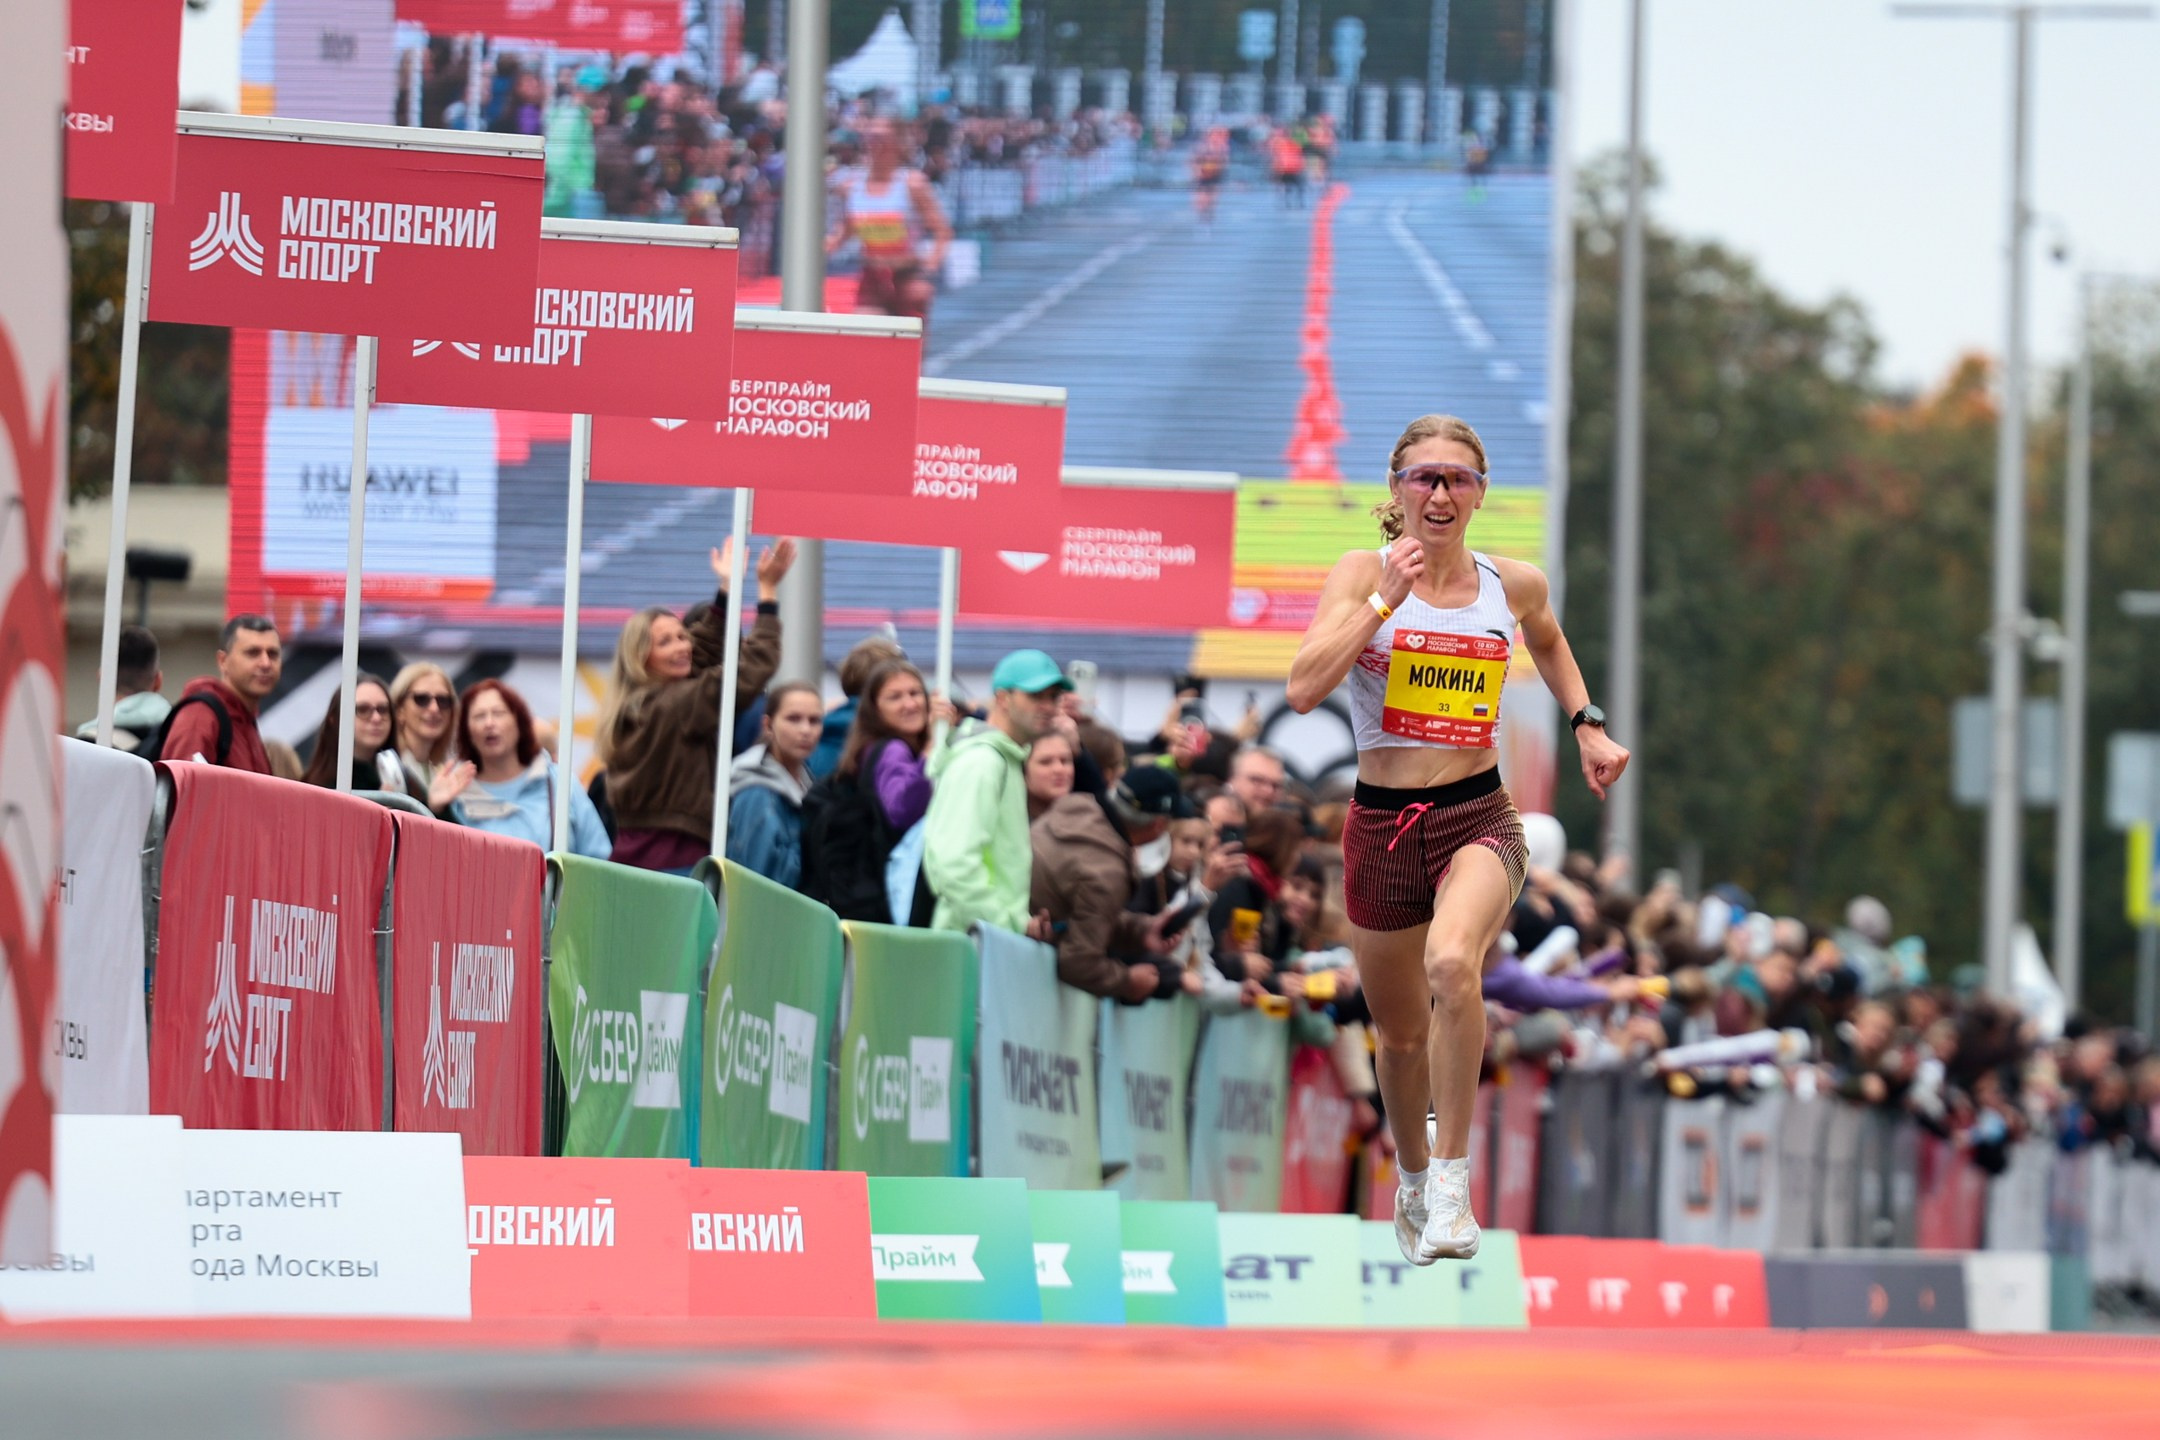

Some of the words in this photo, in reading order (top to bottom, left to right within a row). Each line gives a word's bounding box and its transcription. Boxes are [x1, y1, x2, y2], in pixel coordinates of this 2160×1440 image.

[280, 196, 497, 250] МОСКОВСКИЙ
[278, 239, 381, 284] СПОРТ
[534, 287, 694, 333] СКОВСКИЙ
[729, 396, 871, 421] ОСКОВСКИЙ
[913, 478, 978, 501] АФОН
[1062, 540, 1197, 566] МОСКОВСКИЙ
[1060, 557, 1161, 581] МАРАФОН
[1426, 645, 1457, 654] МАРАФОН
[1427, 640, 1469, 650] МОСКОВСКИЙ
[1409, 664, 1486, 694] МОКИНА
[1438, 702, 1450, 712] 33
[588, 1009, 639, 1084] СБЕР
[256, 1253, 379, 1278] Москвы
